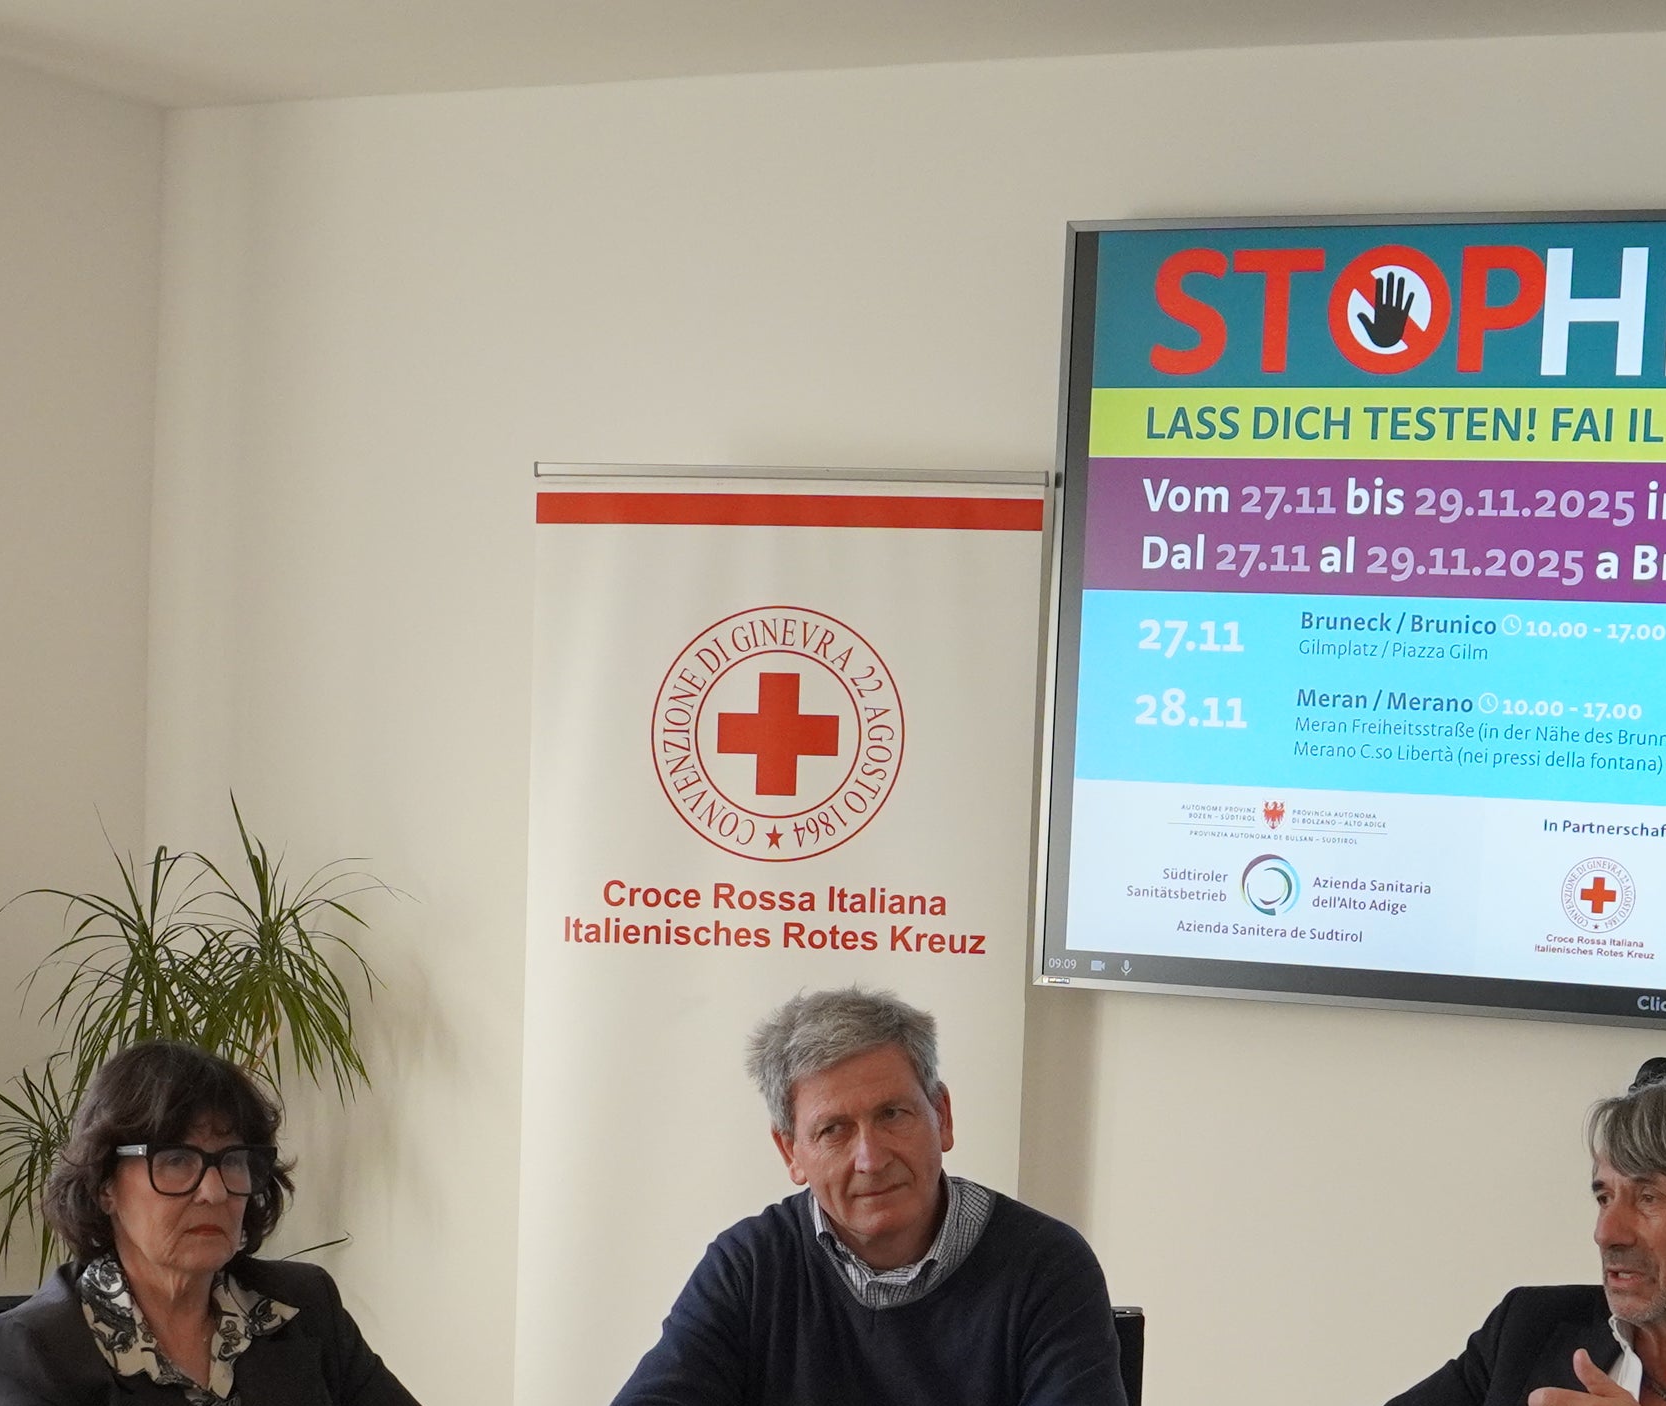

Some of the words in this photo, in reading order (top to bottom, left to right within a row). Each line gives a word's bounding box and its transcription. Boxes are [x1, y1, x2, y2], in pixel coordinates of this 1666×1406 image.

[1145, 404, 1240, 440] LASS
[1252, 405, 1351, 441] DICH
[1363, 406, 1536, 443] TESTEN!
[1552, 407, 1612, 443] FAI
[1628, 408, 1663, 443] IL
[1142, 477, 1230, 514] Vom
[1240, 484, 1337, 522] 27.11
[1345, 476, 1405, 515] bis
[1414, 486, 1635, 527] 29.11.2025
[1141, 533, 1206, 570] Dal
[1215, 542, 1311, 579] 27.11
[1319, 535, 1356, 573] al
[1366, 545, 1585, 585] 29.11.2025
[1595, 552, 1619, 580] a
[1138, 618, 1245, 658] 27.11
[1300, 611, 1392, 634] Bruneck
[1411, 614, 1497, 637] Brunico
[1525, 621, 1588, 640] 10.00
[1606, 623, 1666, 643] 17.00
[694, 637, 733, 678] DI
[731, 617, 854, 673] GINEVRA
[1298, 639, 1379, 661] Gilmplatz
[1392, 642, 1446, 661] Piazza
[1449, 642, 1489, 661] Gilm
[850, 665, 883, 700] 22
[1134, 688, 1247, 730] 28.11
[1296, 689, 1368, 710] Meran
[1387, 692, 1474, 715] Merano
[1502, 698, 1565, 719] 10.00
[1583, 701, 1643, 722] 17.00
[1294, 716, 1348, 735] Meran
[1352, 717, 1474, 739] Freiheitsstraße
[1479, 721, 1499, 742] (in
[1503, 722, 1531, 742] der
[1535, 722, 1580, 744] Nähe
[1585, 726, 1613, 745] des
[664, 667, 757, 846] CONVENZIONE
[843, 705, 895, 814] AGOSTO
[1293, 741, 1357, 760] Merano
[1360, 742, 1393, 761] C.so
[1397, 742, 1454, 764] Libertà
[1458, 744, 1487, 766] (nei
[1493, 749, 1541, 771] pressi
[1545, 749, 1586, 770] della
[1590, 752, 1664, 775] fontana)
[793, 803, 849, 849] 1864
[1542, 819, 1559, 833] In
[1162, 867, 1229, 884] Südtiroler
[1312, 876, 1367, 891] Azienda
[1369, 879, 1431, 896] Sanitaria
[603, 879, 701, 910] Croce
[712, 882, 816, 912] Rossa
[827, 885, 947, 917] Italiana
[1126, 884, 1228, 903] Sanitätsbetrieb
[1312, 896, 1366, 912] dell'Alto
[1369, 899, 1408, 916] Adige
[563, 916, 771, 948] Italienisches
[782, 922, 879, 952] Rotes
[889, 925, 987, 956] Kreuz
[1176, 919, 1229, 935] Azienda
[1232, 922, 1288, 939] Sanitera
[1289, 926, 1307, 940] de
[1309, 928, 1363, 943] Sudtirol
[1546, 933, 1575, 945] Croce
[1577, 935, 1608, 947] Rossa
[1609, 936, 1644, 949] Italiana
[1048, 957, 1077, 970] 09:09
[1596, 947, 1625, 959] Rotes
[1626, 948, 1656, 961] Kreuz
